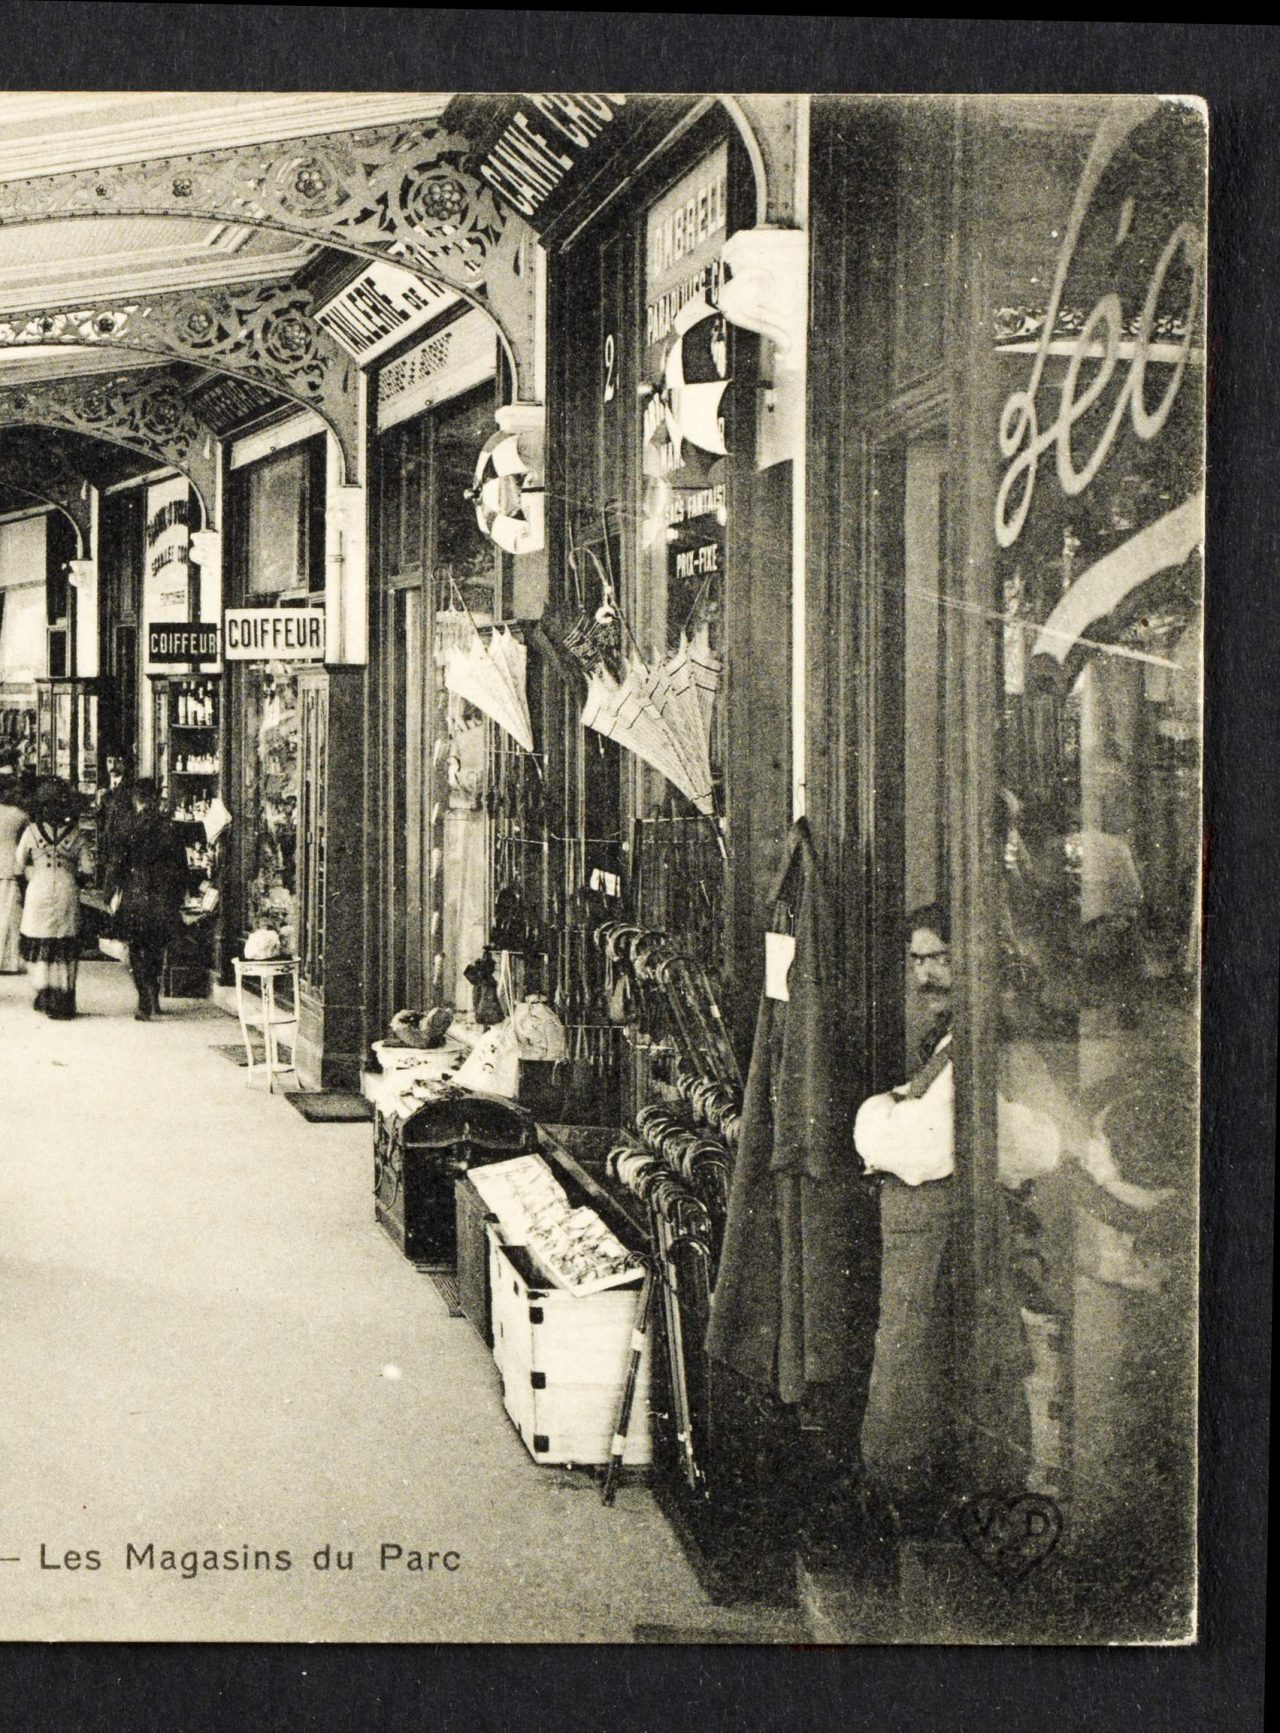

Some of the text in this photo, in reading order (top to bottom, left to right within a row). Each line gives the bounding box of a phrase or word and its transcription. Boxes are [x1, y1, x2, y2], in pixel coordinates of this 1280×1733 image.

[480, 111, 574, 216] CANNE
[320, 276, 411, 356] TAILLERIE
[402, 287, 429, 310] DE
[677, 544, 718, 579] PRIX-FIXE
[151, 632, 216, 654] COIFFEUR
[228, 618, 320, 648] COIFFEUR
